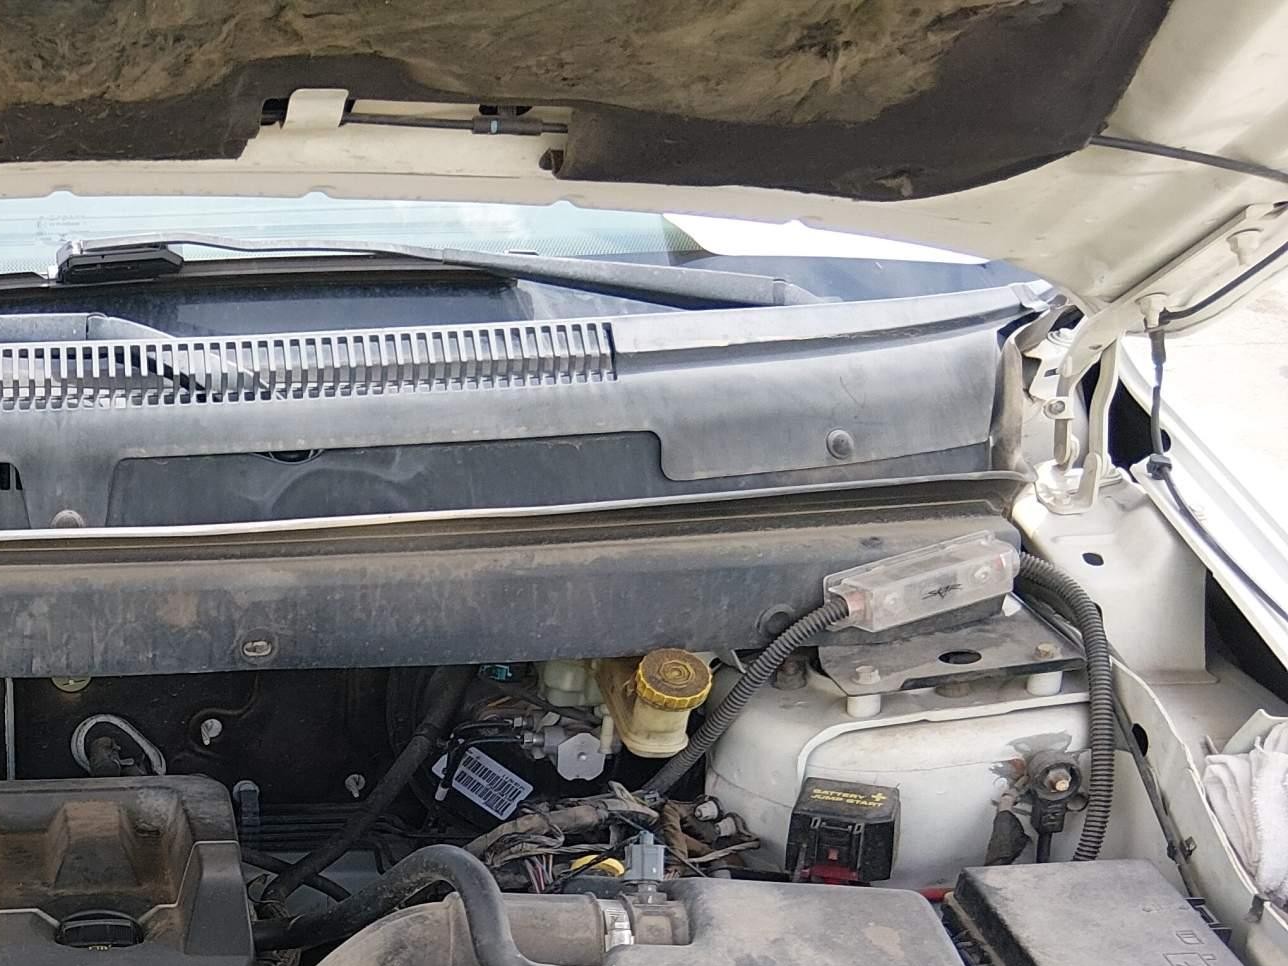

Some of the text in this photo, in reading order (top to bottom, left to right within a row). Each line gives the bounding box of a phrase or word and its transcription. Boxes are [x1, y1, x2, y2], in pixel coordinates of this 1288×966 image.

[812, 788, 866, 799] BATTERY
[810, 794, 884, 807] JUMP START
